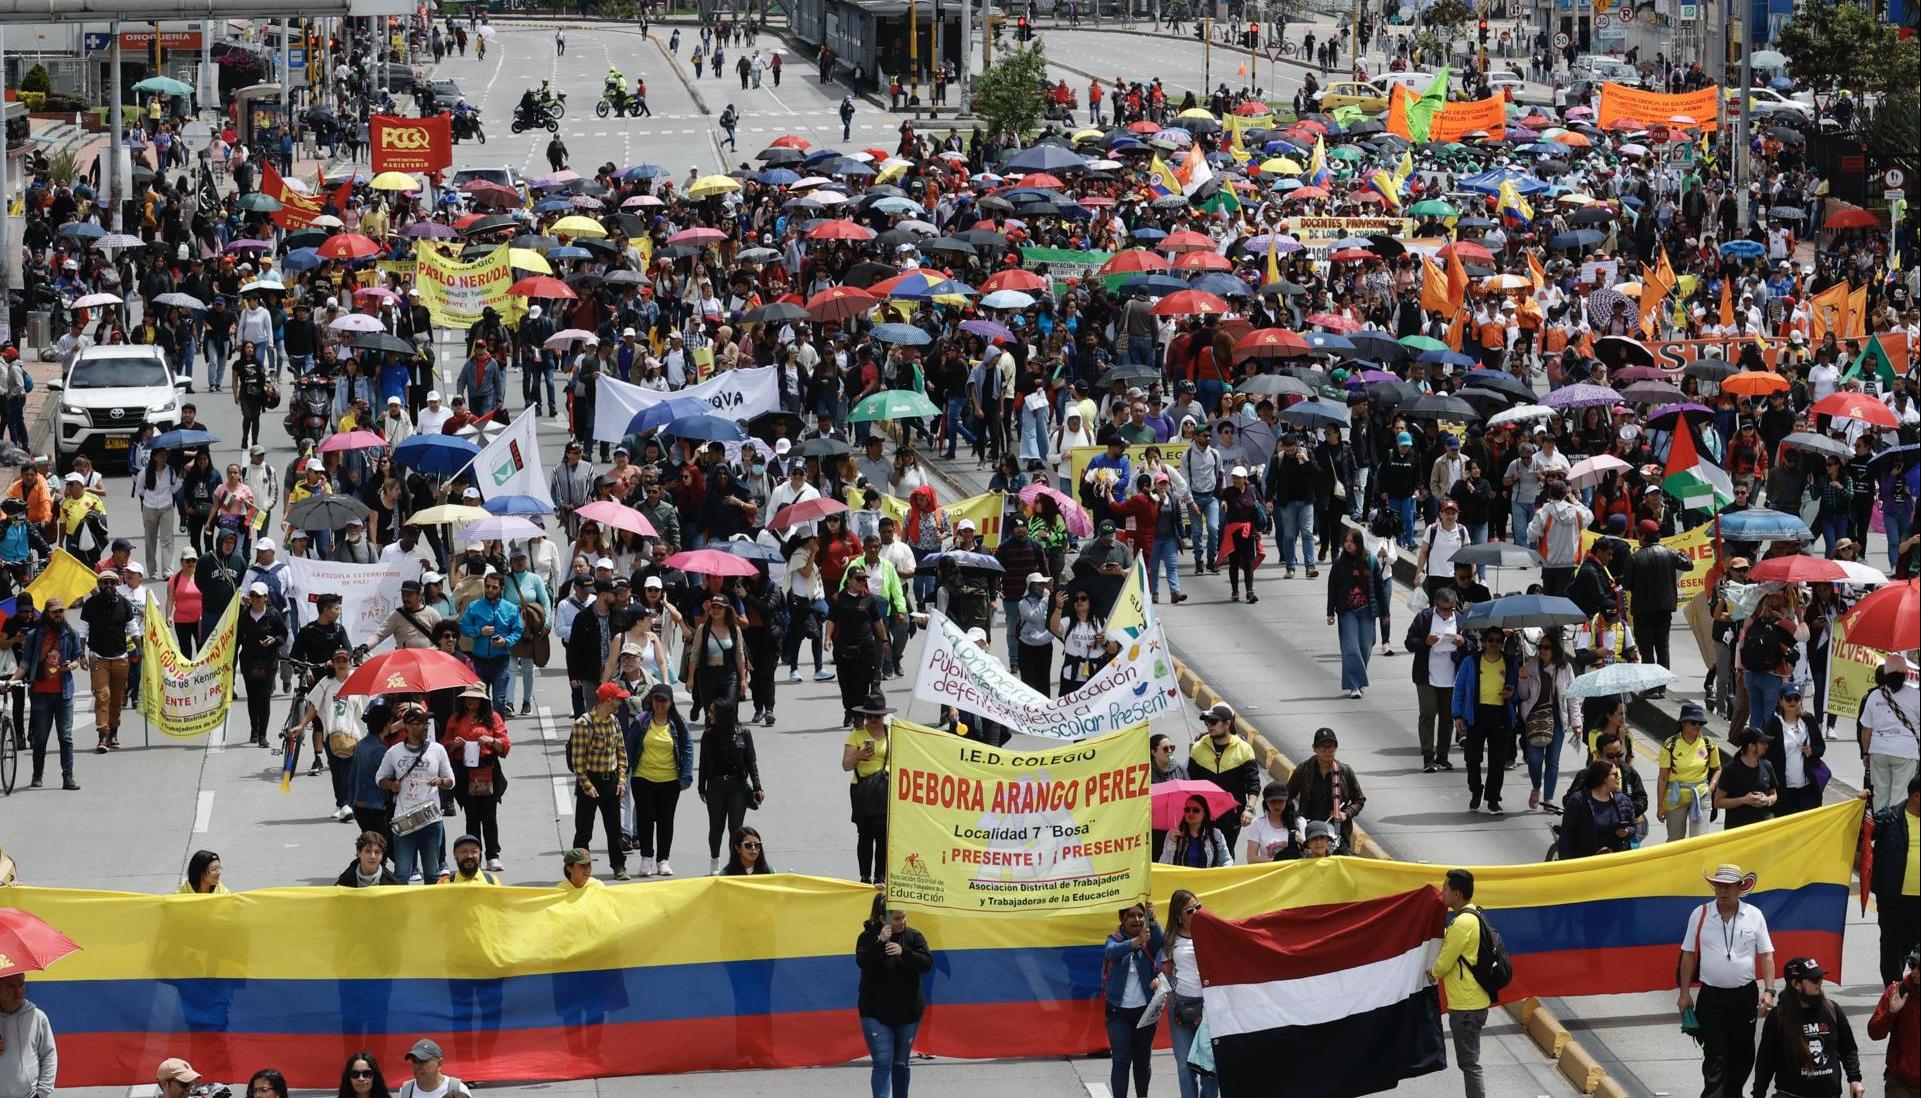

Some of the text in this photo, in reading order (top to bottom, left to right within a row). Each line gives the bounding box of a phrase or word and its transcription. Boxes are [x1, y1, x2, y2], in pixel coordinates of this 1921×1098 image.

[1555, 36, 1567, 45] 50
[1301, 218, 1342, 229] DOCENTES
[1309, 229, 1319, 238] DE
[418, 262, 455, 286] PABLO
[460, 264, 509, 288] NERUDA
[321, 572, 351, 580] ESCUELA
[362, 571, 401, 579] TERRITORIO
[183, 713, 208, 723] Distrital
[960, 748, 1096, 766] I.E.D. COLEGIO
[898, 763, 1150, 814] DEBORA ARANGO PEREZ
[954, 824, 1027, 840] Localidad
[1033, 826, 1041, 839] 7
[951, 848, 1033, 866] PRESENTE
[1062, 834, 1142, 860] PRESENTE
[968, 872, 1130, 892] Asociación Distrital de Trabajadores
[890, 887, 944, 903] Educación
[980, 898, 986, 907] y
[988, 897, 1046, 907] Trabajadoras
[1048, 895, 1059, 903] de
[1073, 888, 1120, 902] Educación
